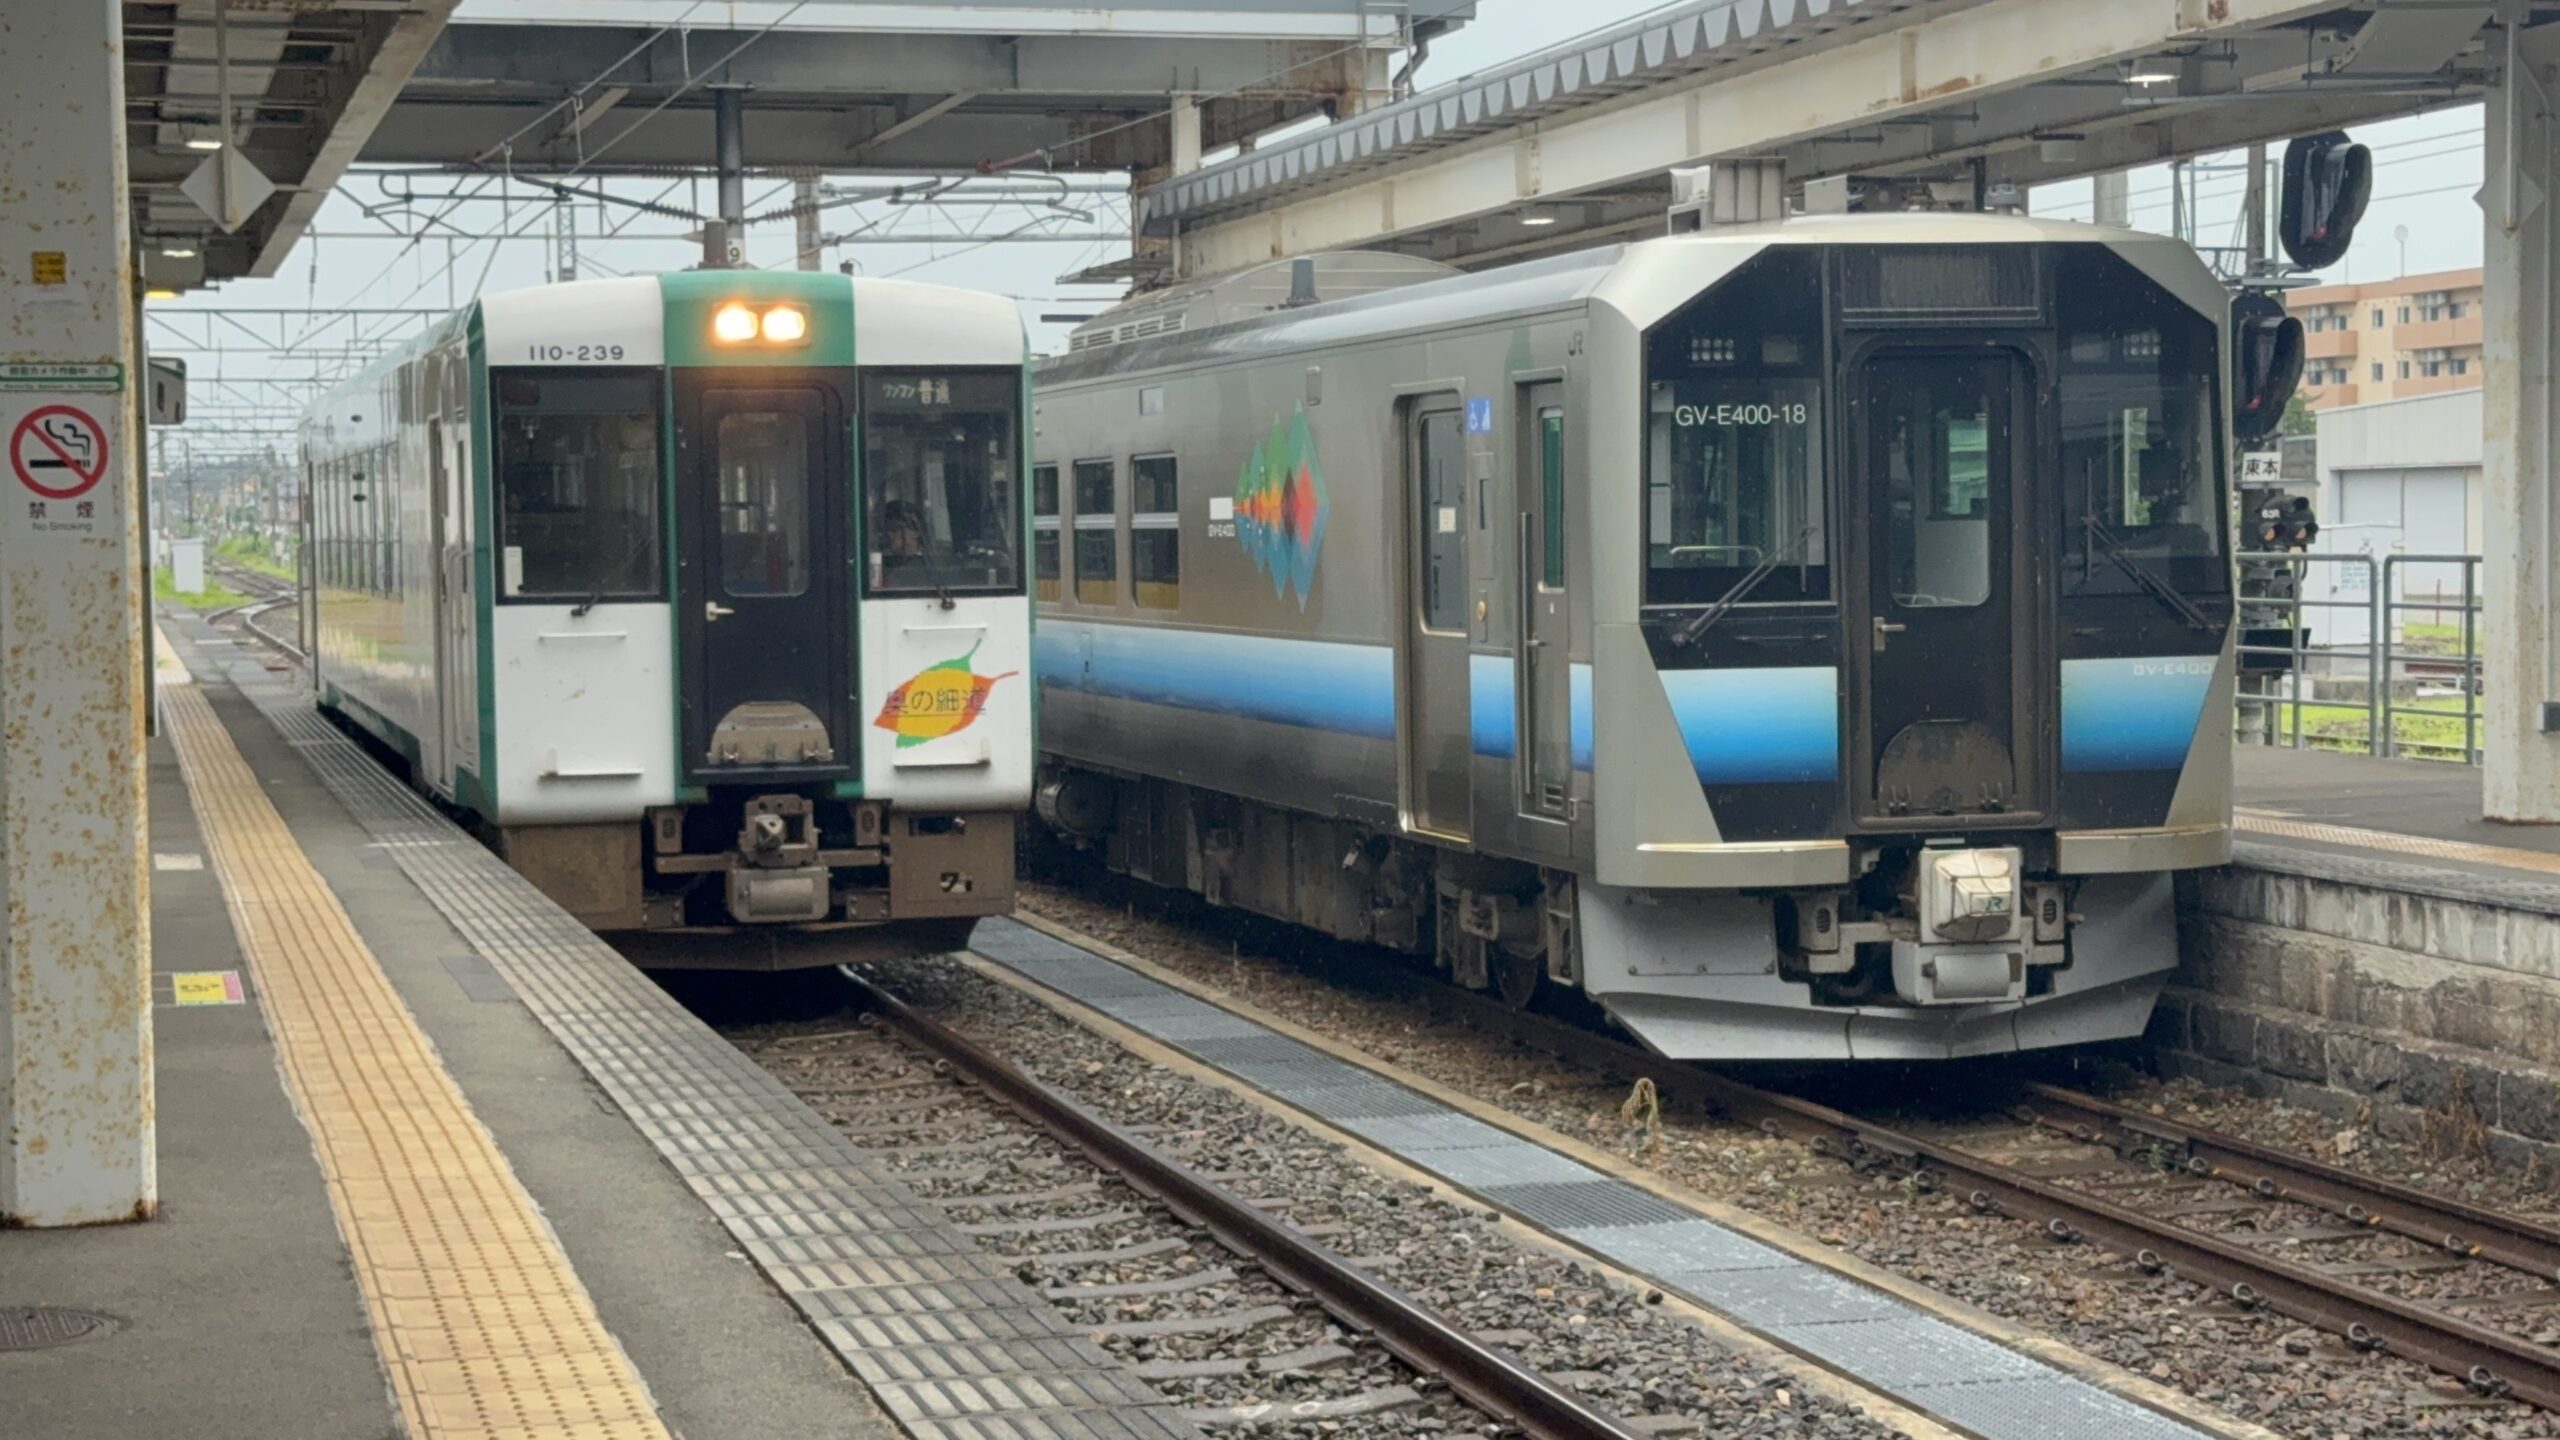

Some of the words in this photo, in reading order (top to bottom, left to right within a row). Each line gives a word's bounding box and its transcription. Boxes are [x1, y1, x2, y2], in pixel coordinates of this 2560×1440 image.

[529, 345, 624, 361] 110-239
[1675, 404, 1806, 426] GV-E400-18
[2245, 458, 2279, 476] 東本
[29, 501, 96, 519] 禁煙
[49, 522, 92, 533] Smoking
[881, 687, 986, 715] 奥の細道
